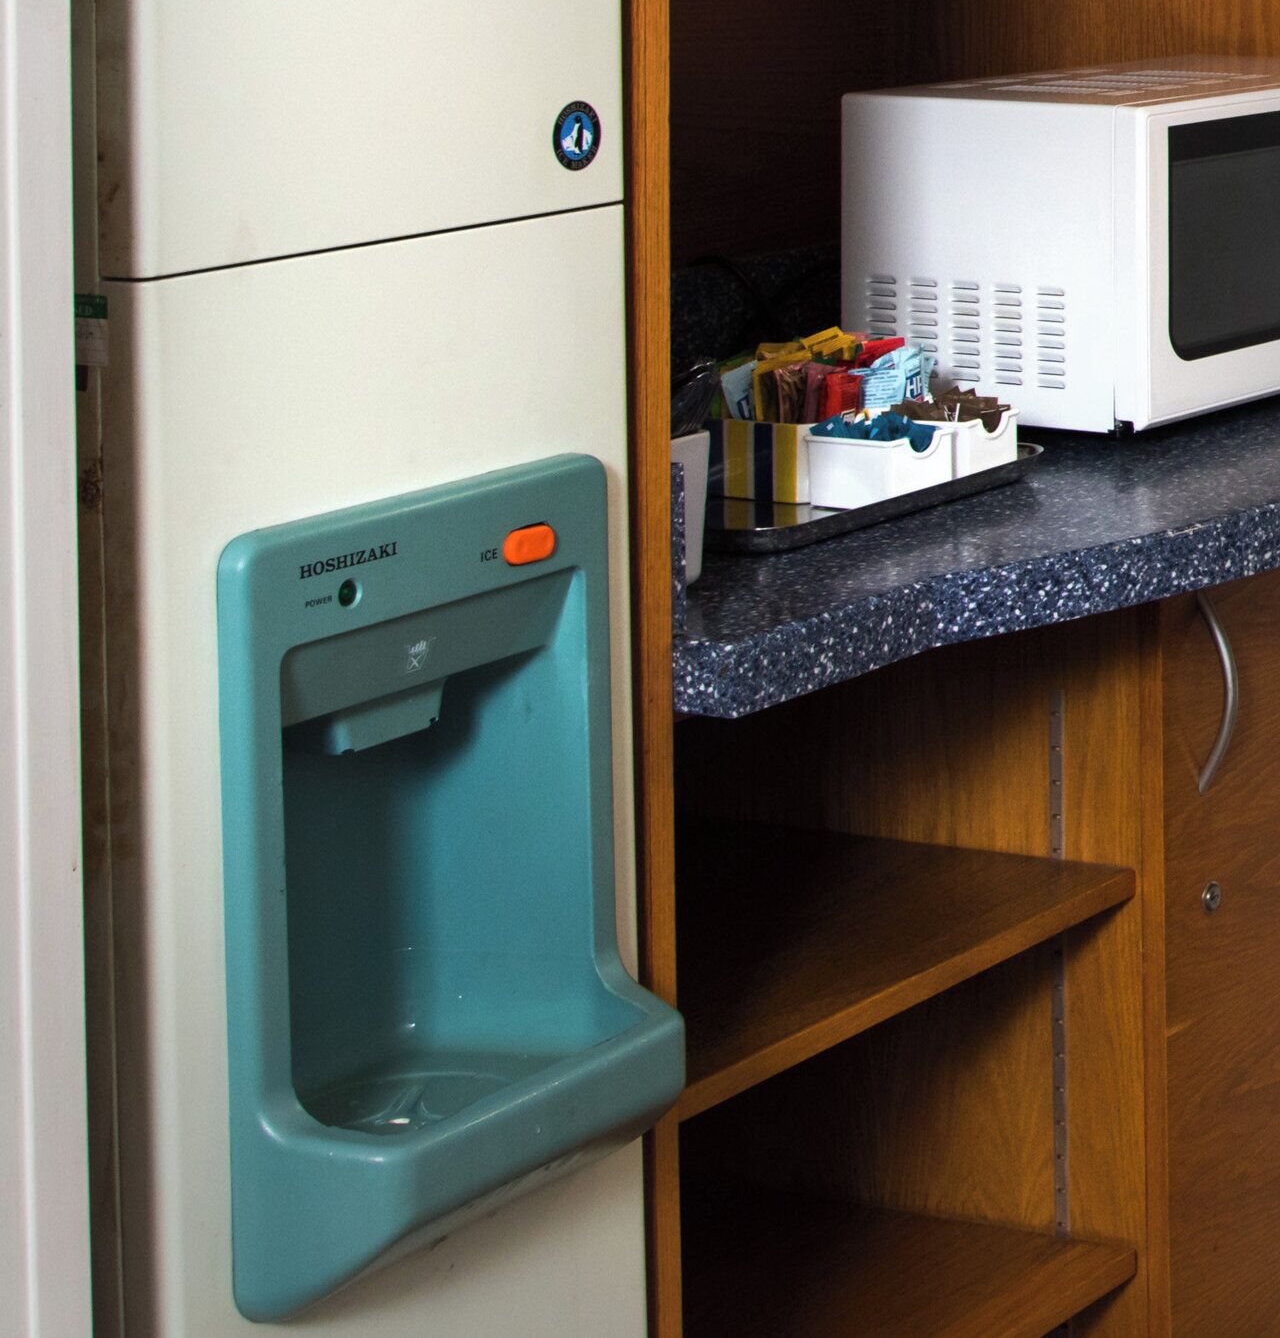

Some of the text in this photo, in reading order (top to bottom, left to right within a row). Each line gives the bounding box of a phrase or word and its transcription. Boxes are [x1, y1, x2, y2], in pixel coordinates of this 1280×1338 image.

[559, 102, 598, 124] HOSHIZAKI
[300, 542, 398, 579] HOSHIZAKI
[480, 548, 498, 563] ICE
[305, 595, 333, 608] POWER
